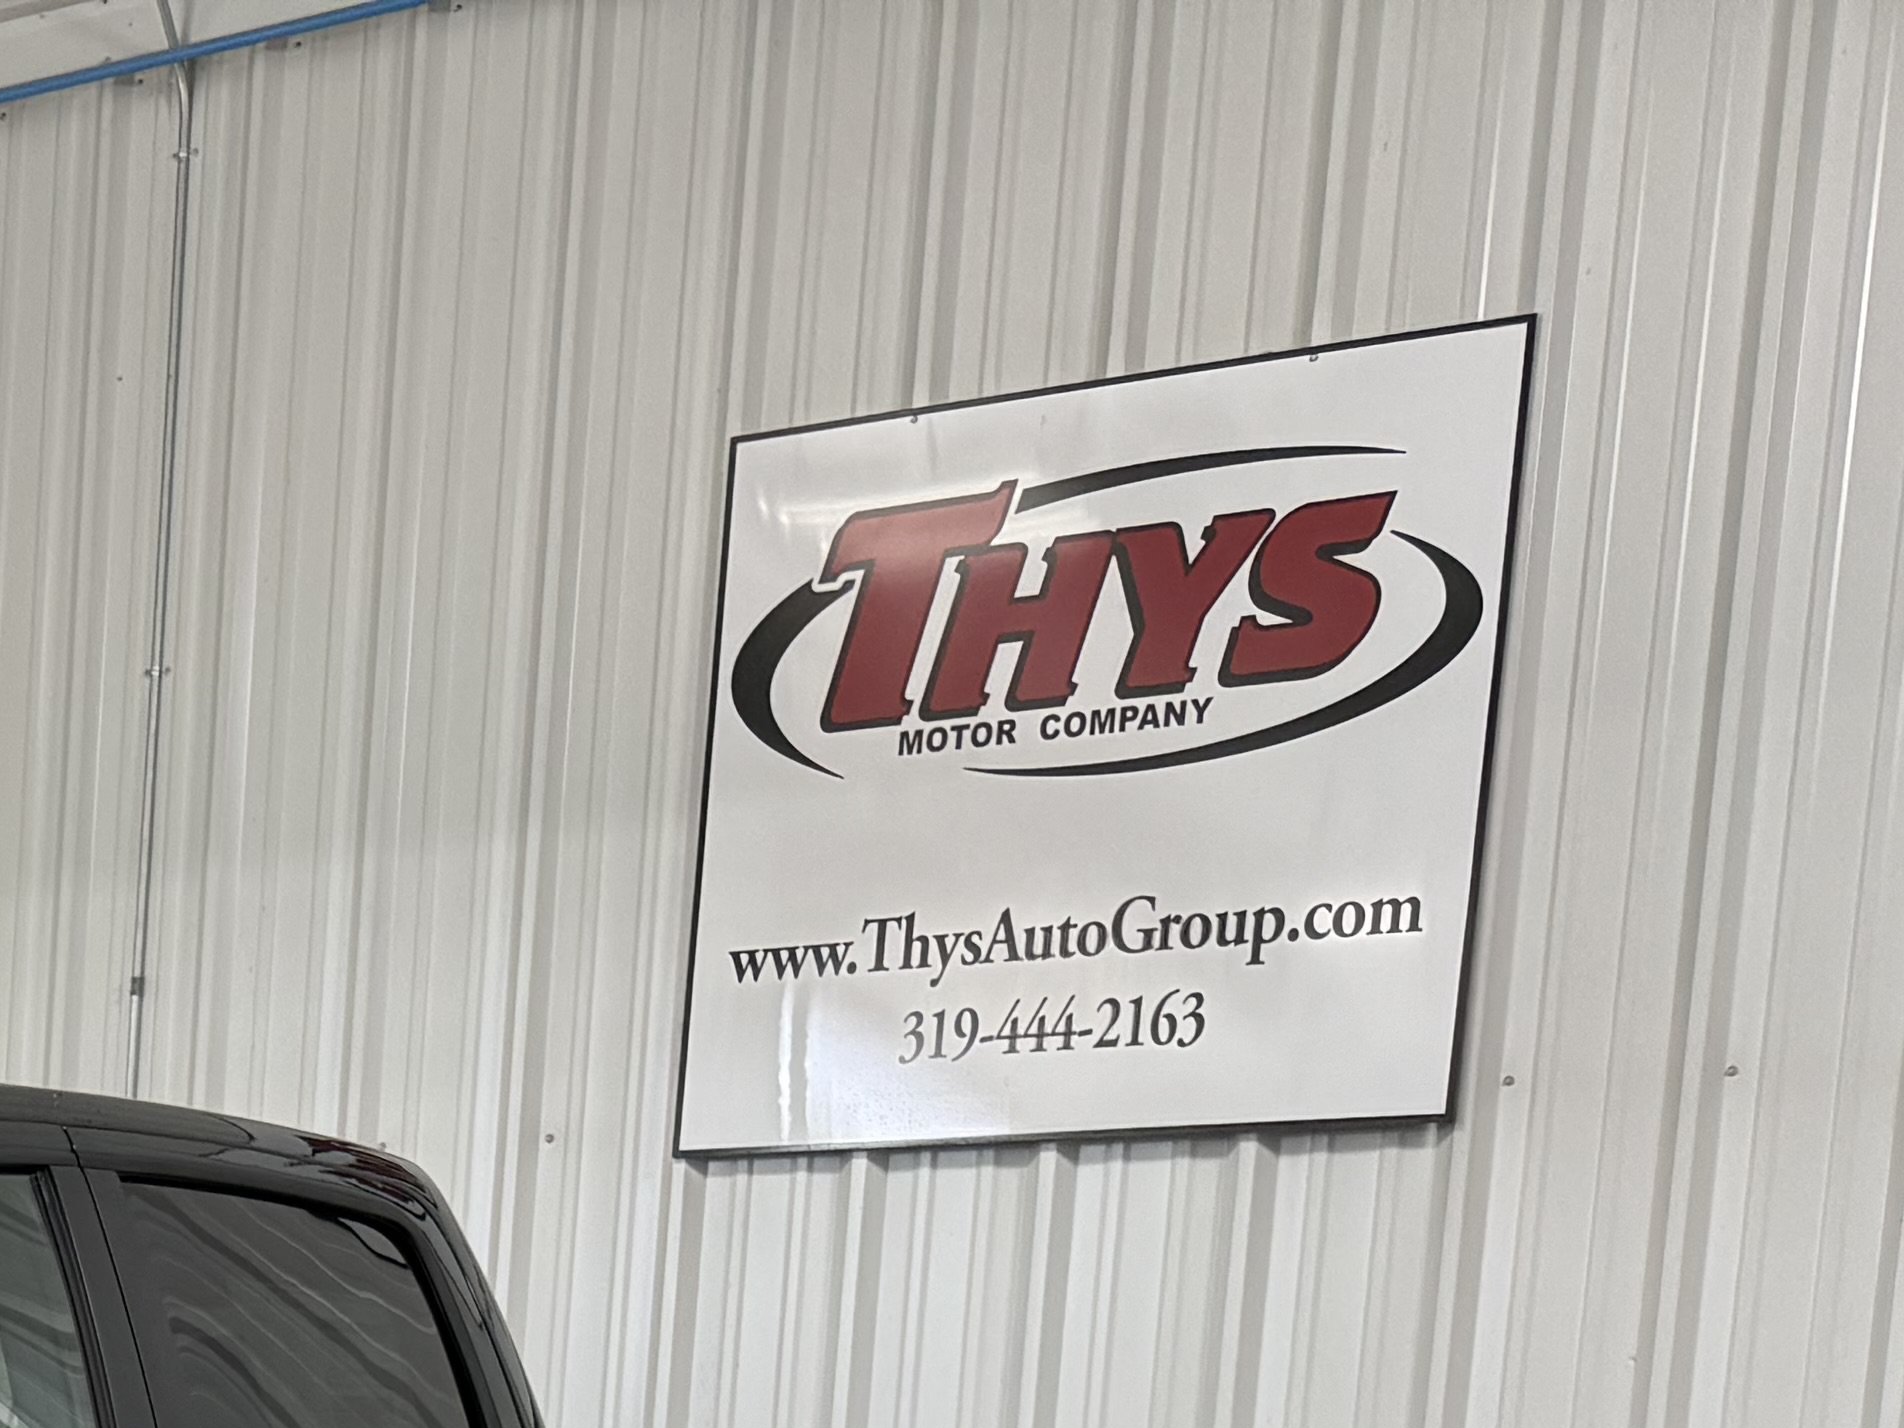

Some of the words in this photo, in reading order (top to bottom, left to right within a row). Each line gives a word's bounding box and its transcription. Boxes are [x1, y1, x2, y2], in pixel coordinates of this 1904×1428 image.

[813, 478, 1398, 733] THYS
[897, 717, 1017, 757] MOTOR
[1039, 696, 1214, 742] COMPANY
[729, 892, 1424, 988] www.ThysAutoGroup.com
[897, 989, 1207, 1066] 319-444-2163
